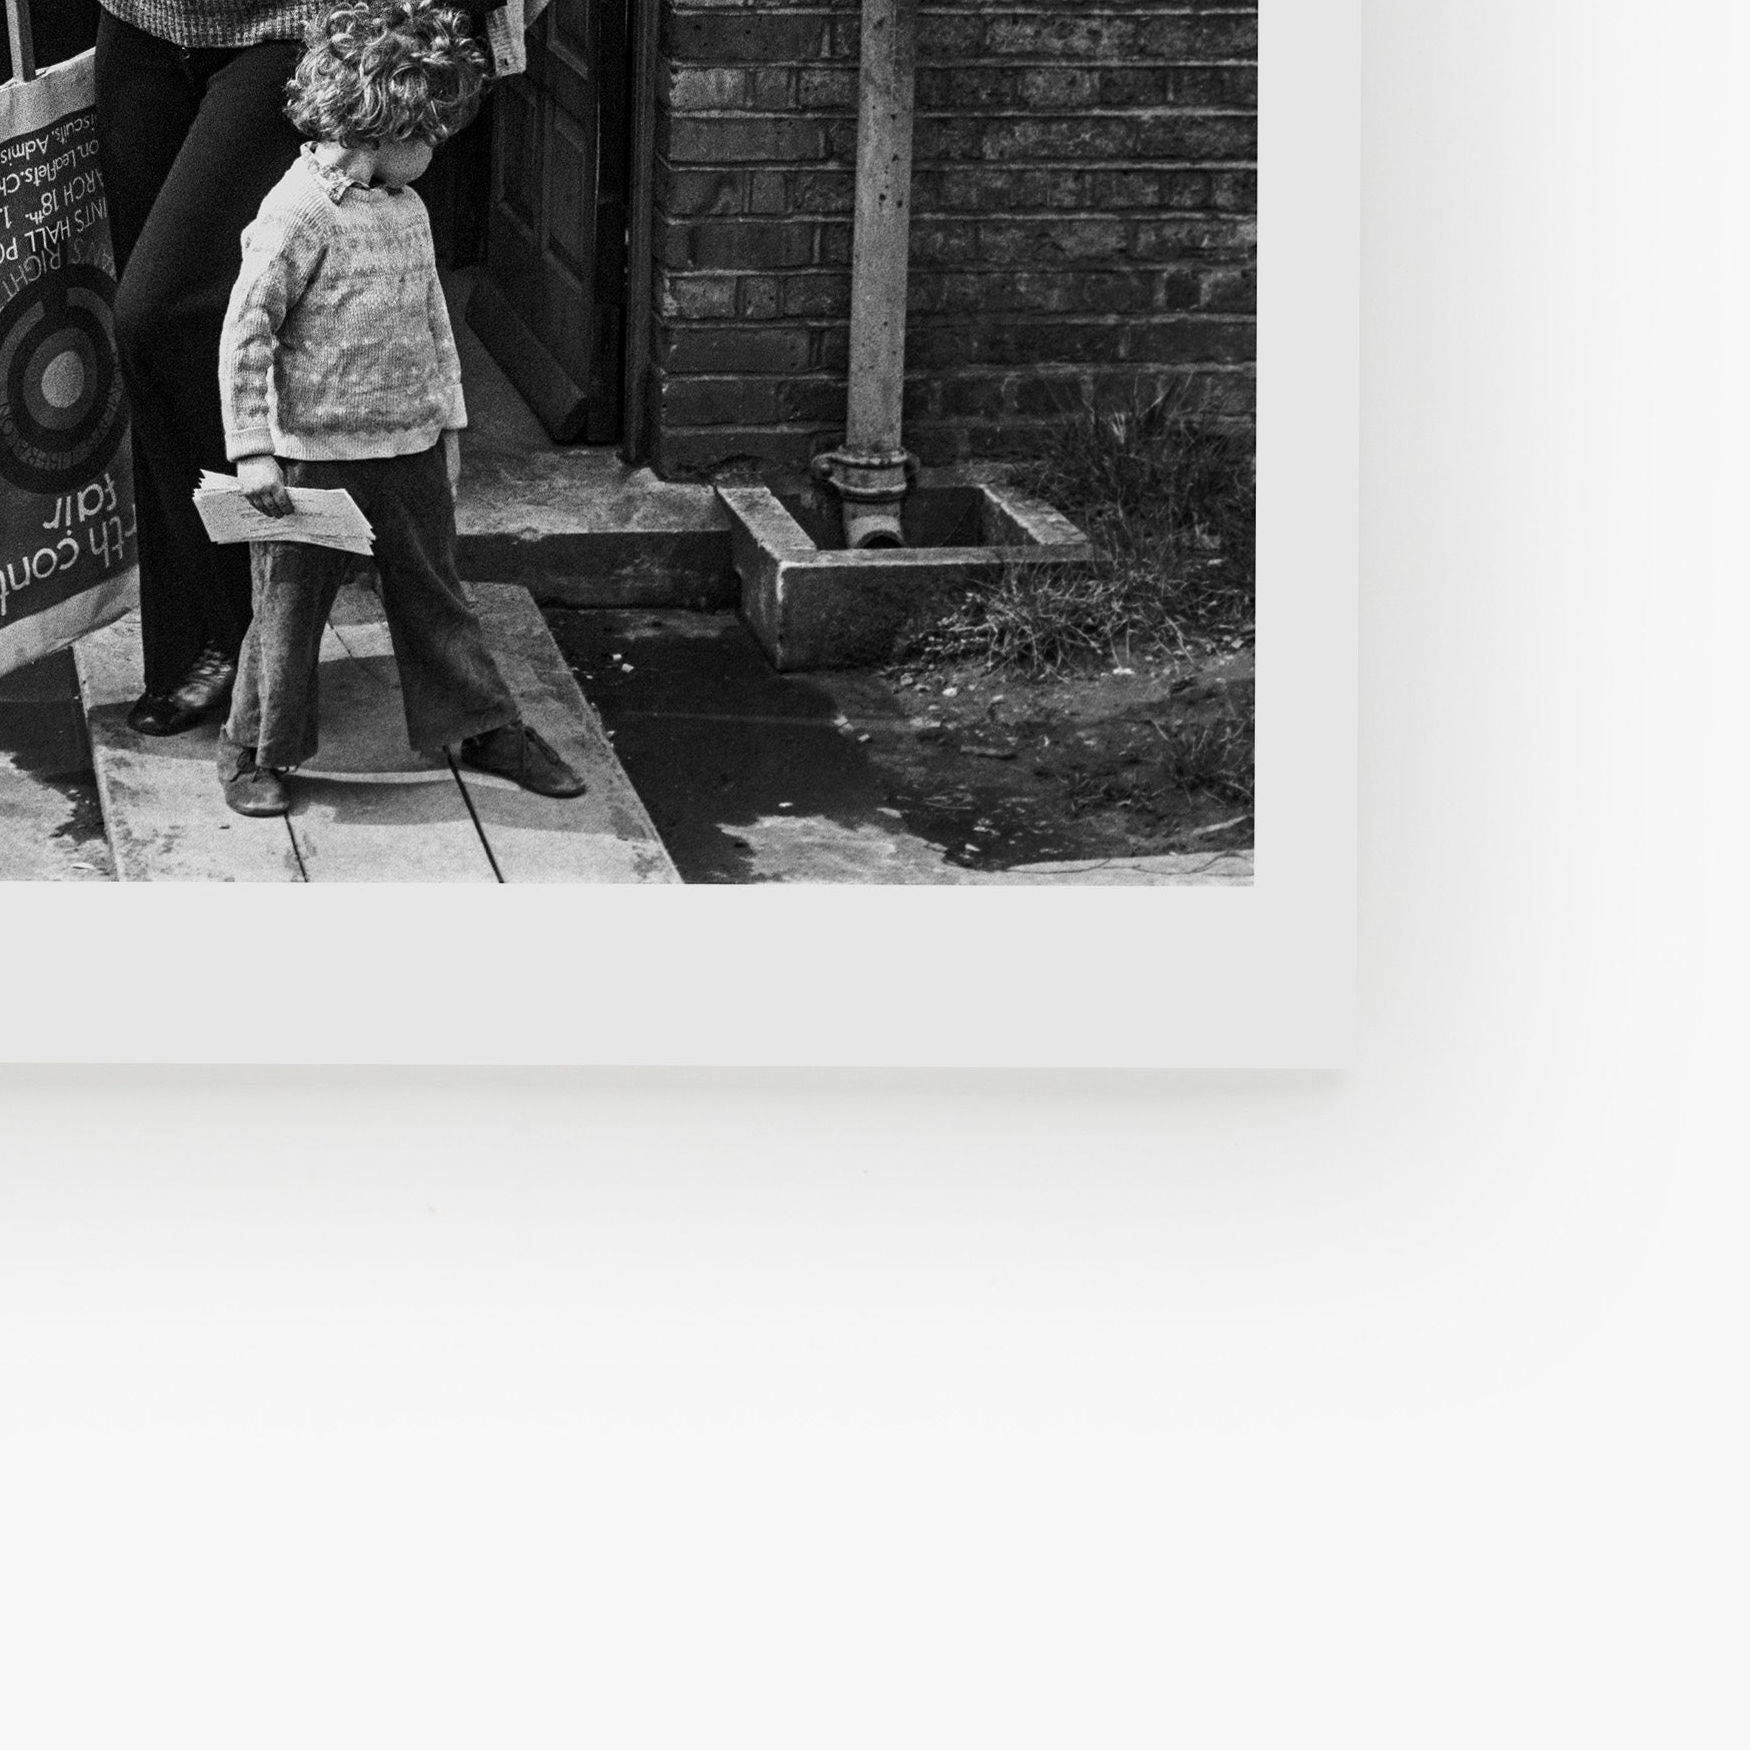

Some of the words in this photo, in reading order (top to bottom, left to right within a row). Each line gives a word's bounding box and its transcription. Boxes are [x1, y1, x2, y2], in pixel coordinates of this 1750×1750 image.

[51, 113, 97, 146] iscuits.
[24, 216, 71, 253] HALL
[2, 240, 62, 301] RIGHT
[43, 472, 117, 536] fair
